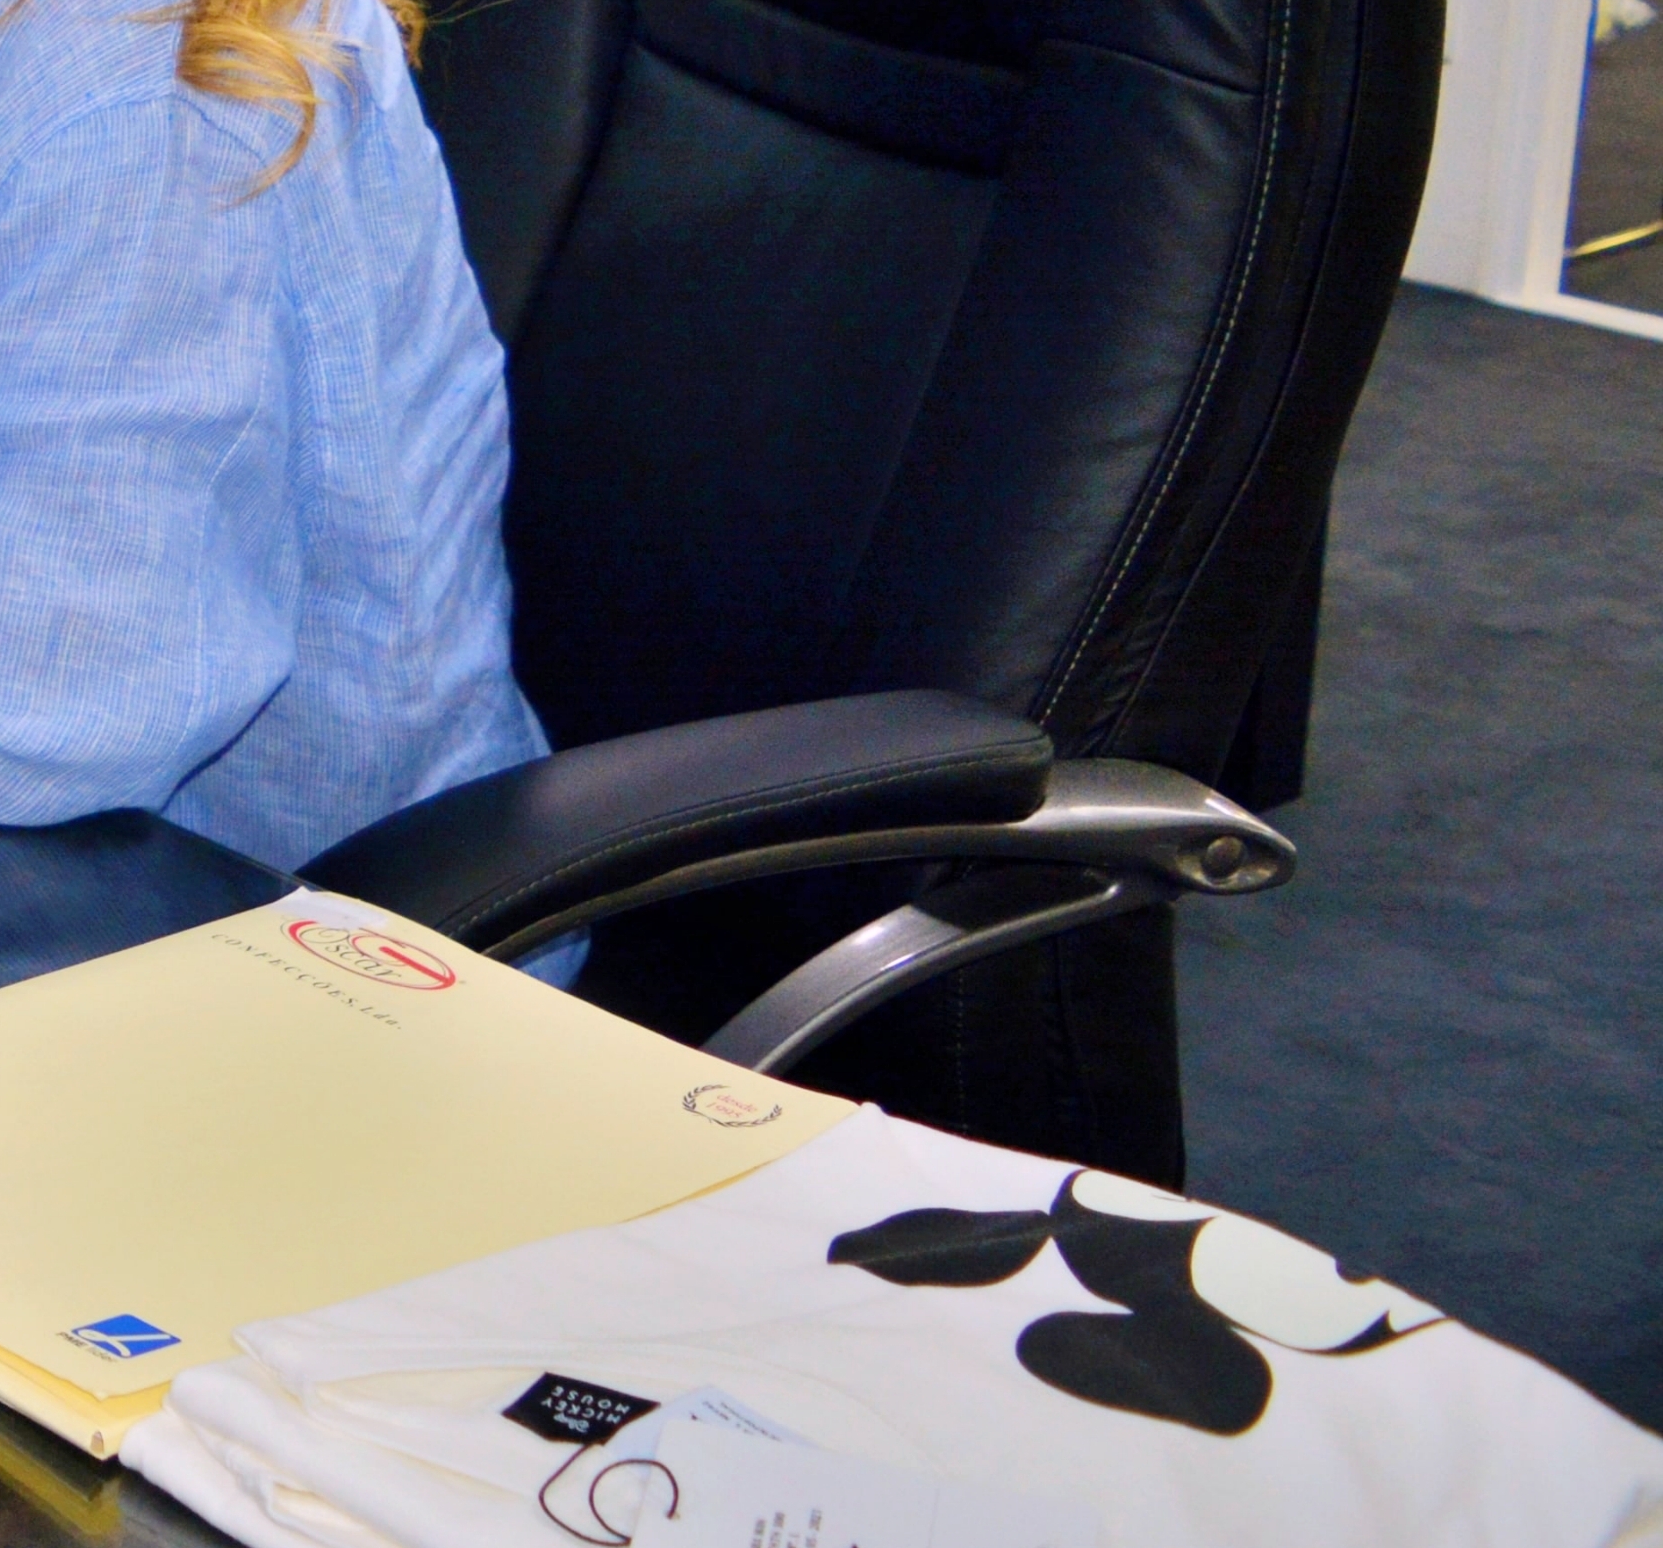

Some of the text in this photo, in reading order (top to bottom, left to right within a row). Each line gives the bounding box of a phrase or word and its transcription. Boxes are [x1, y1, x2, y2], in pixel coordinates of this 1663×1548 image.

[296, 925, 402, 980] Oscar
[540, 1397, 622, 1424] MICKEY
[551, 1385, 632, 1414] MOUSE
